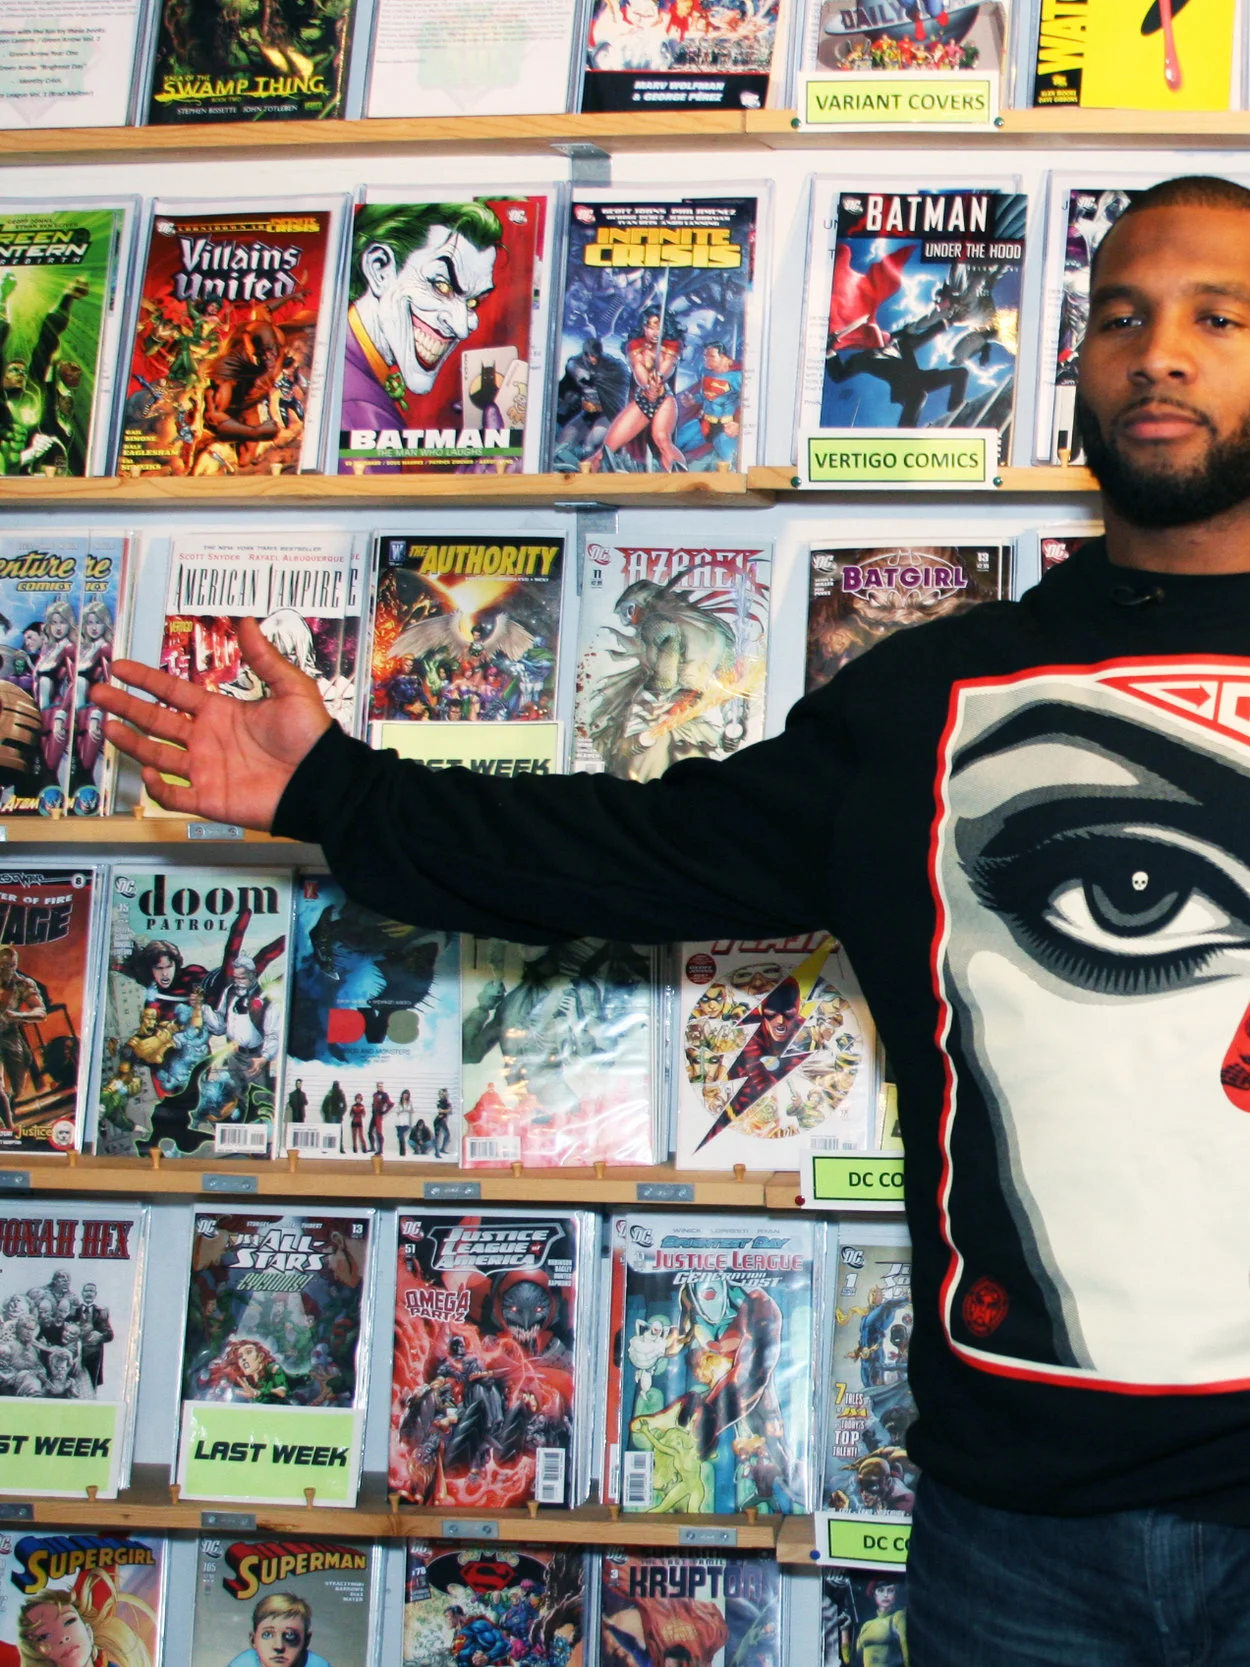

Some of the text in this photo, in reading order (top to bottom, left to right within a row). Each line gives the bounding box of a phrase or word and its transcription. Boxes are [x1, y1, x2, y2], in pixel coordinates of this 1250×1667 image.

[841, 0, 908, 30] DAILY
[163, 75, 327, 96] SWAMP THING
[634, 81, 725, 91] MARV WOLFMAN
[643, 92, 687, 102] GEORGE
[816, 93, 985, 111] VARIANT COVERS
[866, 195, 988, 232] BATMAN
[597, 227, 731, 245] INFINITE
[179, 235, 302, 272] Villains
[584, 244, 742, 268] CRISIS
[925, 242, 1022, 260] UNDER THE HOOD
[350, 428, 511, 450] BATMAN
[815, 453, 979, 469] VERTIGO COMICS
[179, 553, 345, 563] SCOTT SNYDER RAFAEL ALBUQUERQUE
[409, 545, 427, 557] THE
[421, 545, 560, 576] AUTHORITY
[173, 563, 261, 614] AMERICAN
[266, 563, 342, 615] VAMPIRE
[841, 565, 968, 593] BATGIRL
[469, 758, 551, 778] WEEK
[23, 894, 74, 905] OF FIRE
[138, 874, 281, 917] doom
[146, 918, 228, 931] PATROL
[849, 1171, 874, 1188] DC
[351, 1224, 364, 1235] 13
[443, 1228, 550, 1242] JUSTICE
[78, 1220, 135, 1260] HEX
[258, 1229, 327, 1253] ALL-
[404, 1243, 416, 1254] 51
[441, 1240, 528, 1256] LEAGUE
[661, 1235, 792, 1249] BRIGHTEST DAY
[228, 1247, 331, 1272] STARS
[434, 1253, 537, 1270] AMERICA
[652, 1250, 804, 1271] JUSTICE LEAGUE
[672, 1270, 767, 1286] GENERATION
[740, 1276, 783, 1288] LOST
[405, 1288, 471, 1313] OMEGA
[410, 1307, 466, 1323] PART 2
[835, 1383, 865, 1406] 7 TALES
[35, 1436, 112, 1458] WEEK
[834, 1430, 860, 1446] TOP
[194, 1440, 350, 1468] LAST WEEK
[863, 1534, 889, 1551] DC
[12, 1537, 156, 1595] SUPERGIRL
[222, 1542, 368, 1600] SUPERMAN
[628, 1566, 763, 1600] KRYPTON
